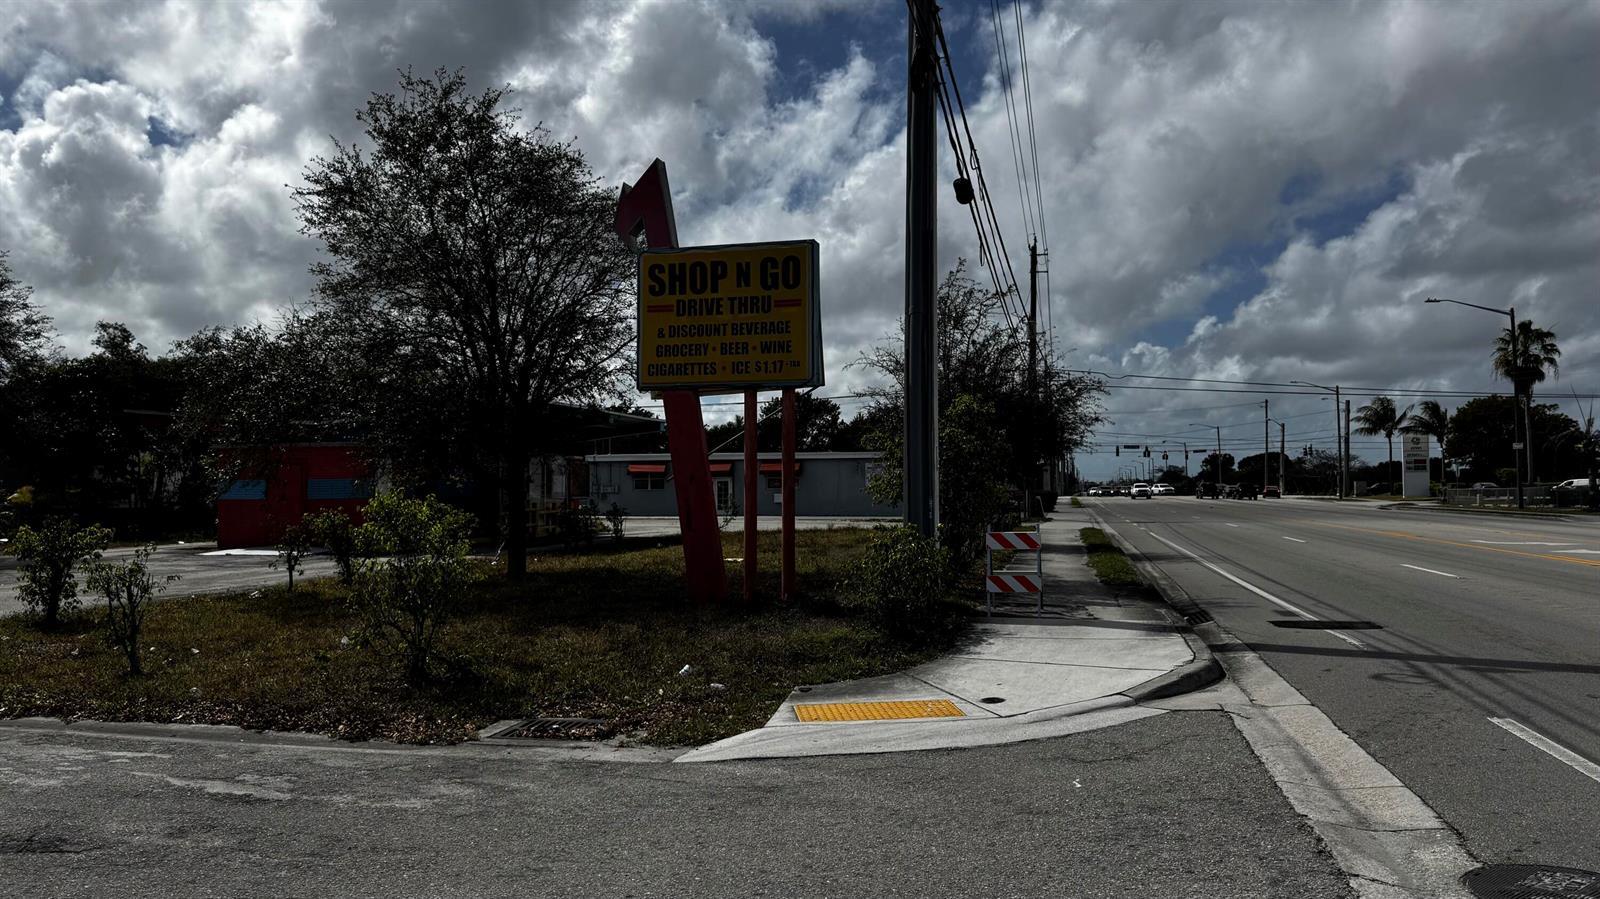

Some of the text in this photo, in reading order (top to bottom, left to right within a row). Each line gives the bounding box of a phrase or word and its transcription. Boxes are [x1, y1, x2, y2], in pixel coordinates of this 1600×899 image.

[648, 255, 801, 296] SHOP N GO
[676, 296, 772, 317] DRIVE THRU
[657, 320, 791, 338] & DISCOUNT BEVERAGE
[656, 340, 792, 357] GROCERY BEER WINE
[647, 362, 717, 377] CIGARETTES
[732, 361, 751, 374] ICE
